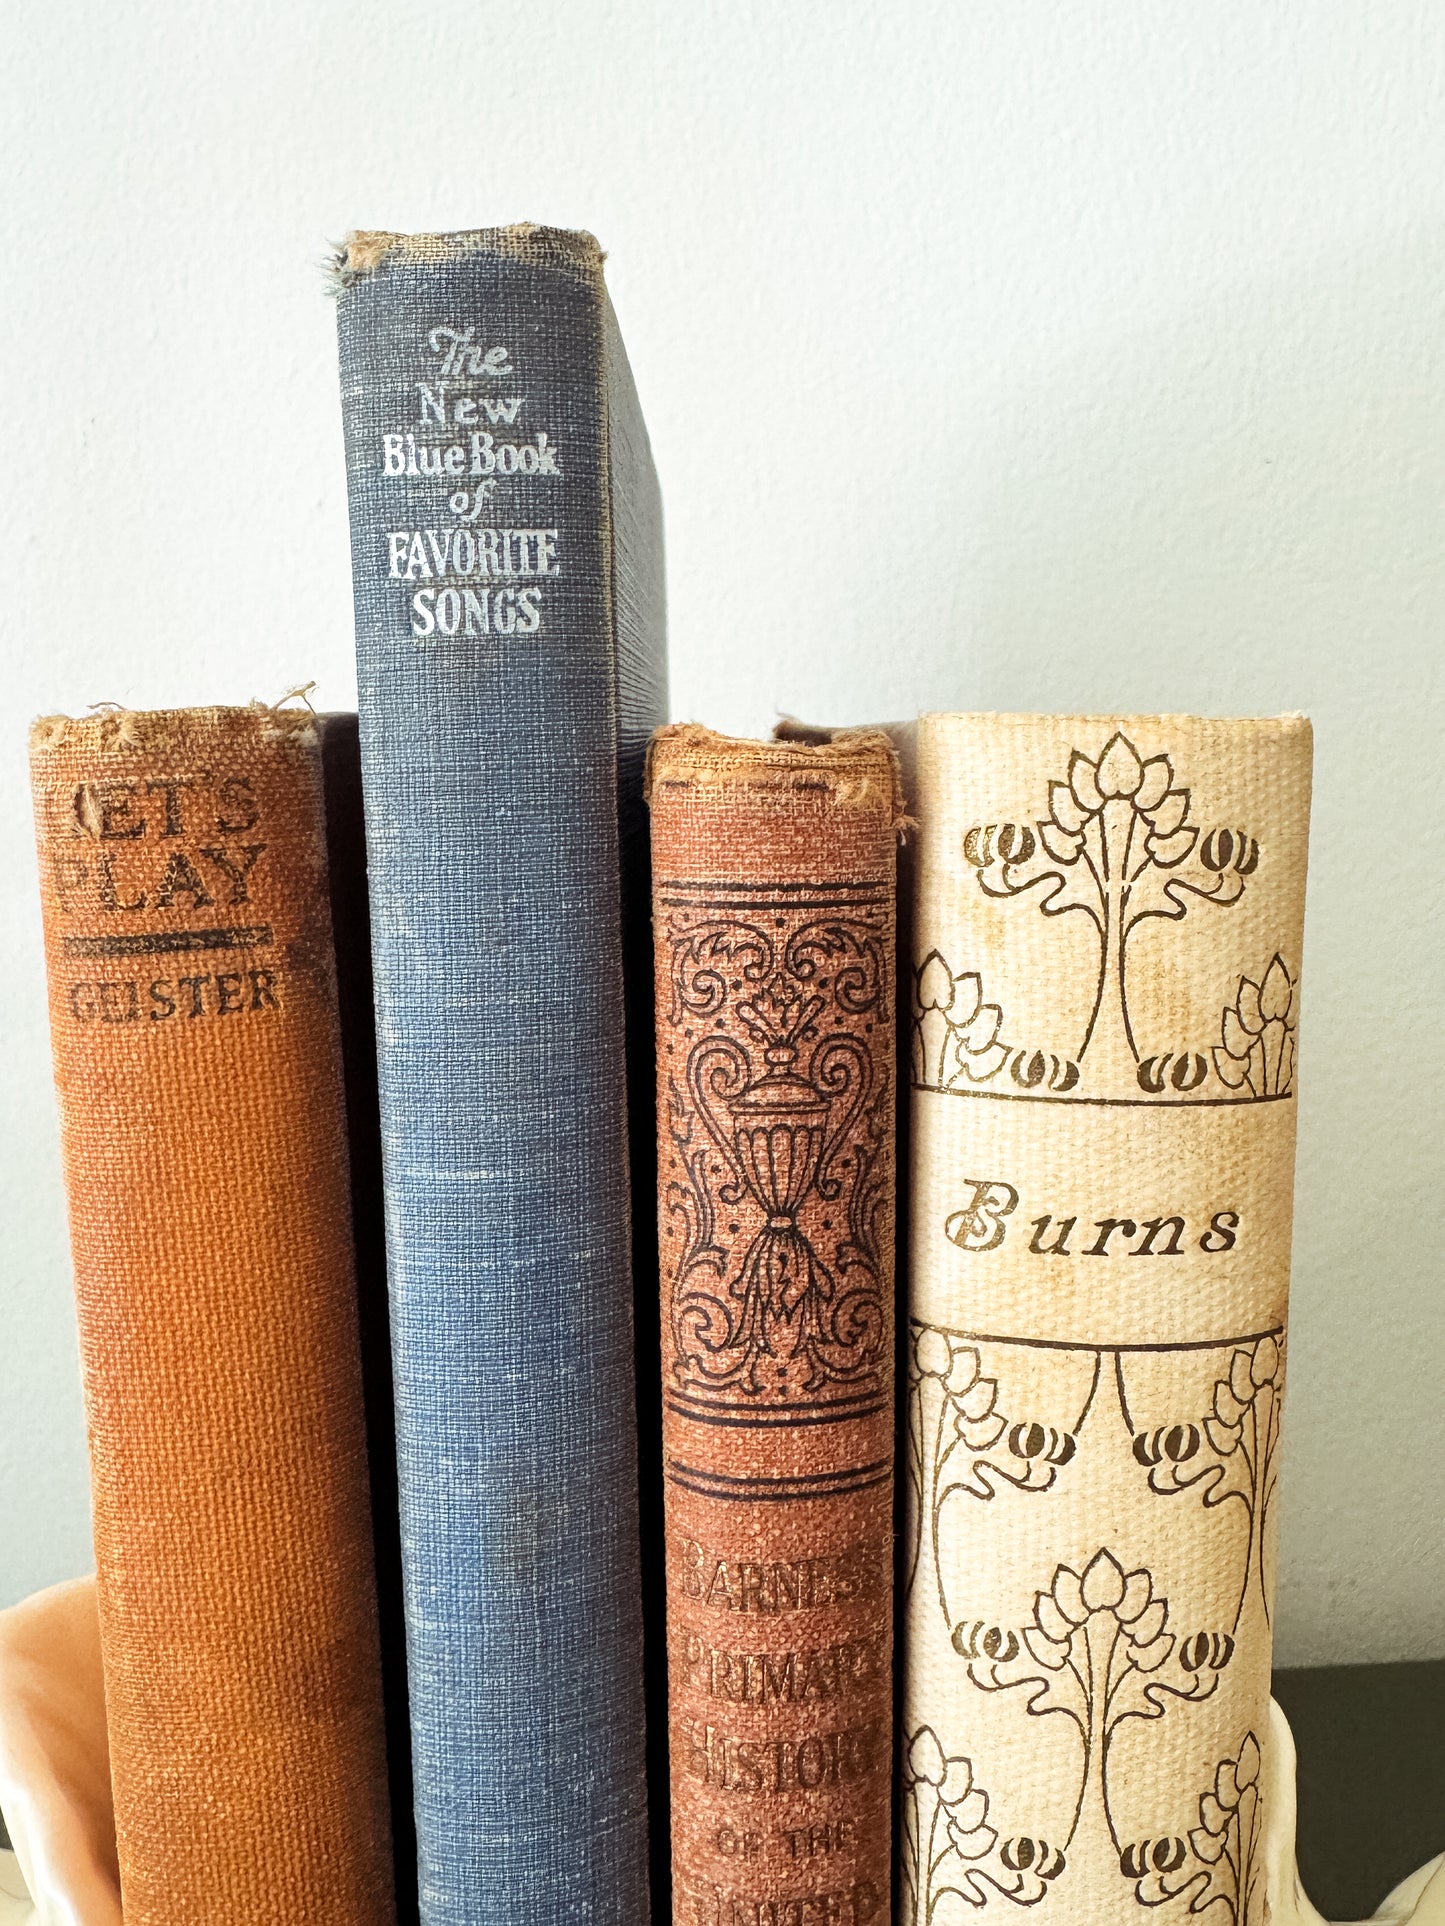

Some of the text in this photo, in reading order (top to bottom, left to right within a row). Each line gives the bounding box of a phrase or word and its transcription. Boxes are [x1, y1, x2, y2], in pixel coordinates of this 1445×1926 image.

[428, 325, 513, 376] The
[416, 380, 526, 425] New
[383, 431, 561, 476] Blue Book
[449, 478, 498, 523] of
[387, 528, 561, 580] FAVORITE
[411, 587, 543, 636] SONGS
[70, 769, 262, 840] ET'S
[68, 968, 285, 1023] GEISTER
[945, 1178, 1240, 1257] Burns
